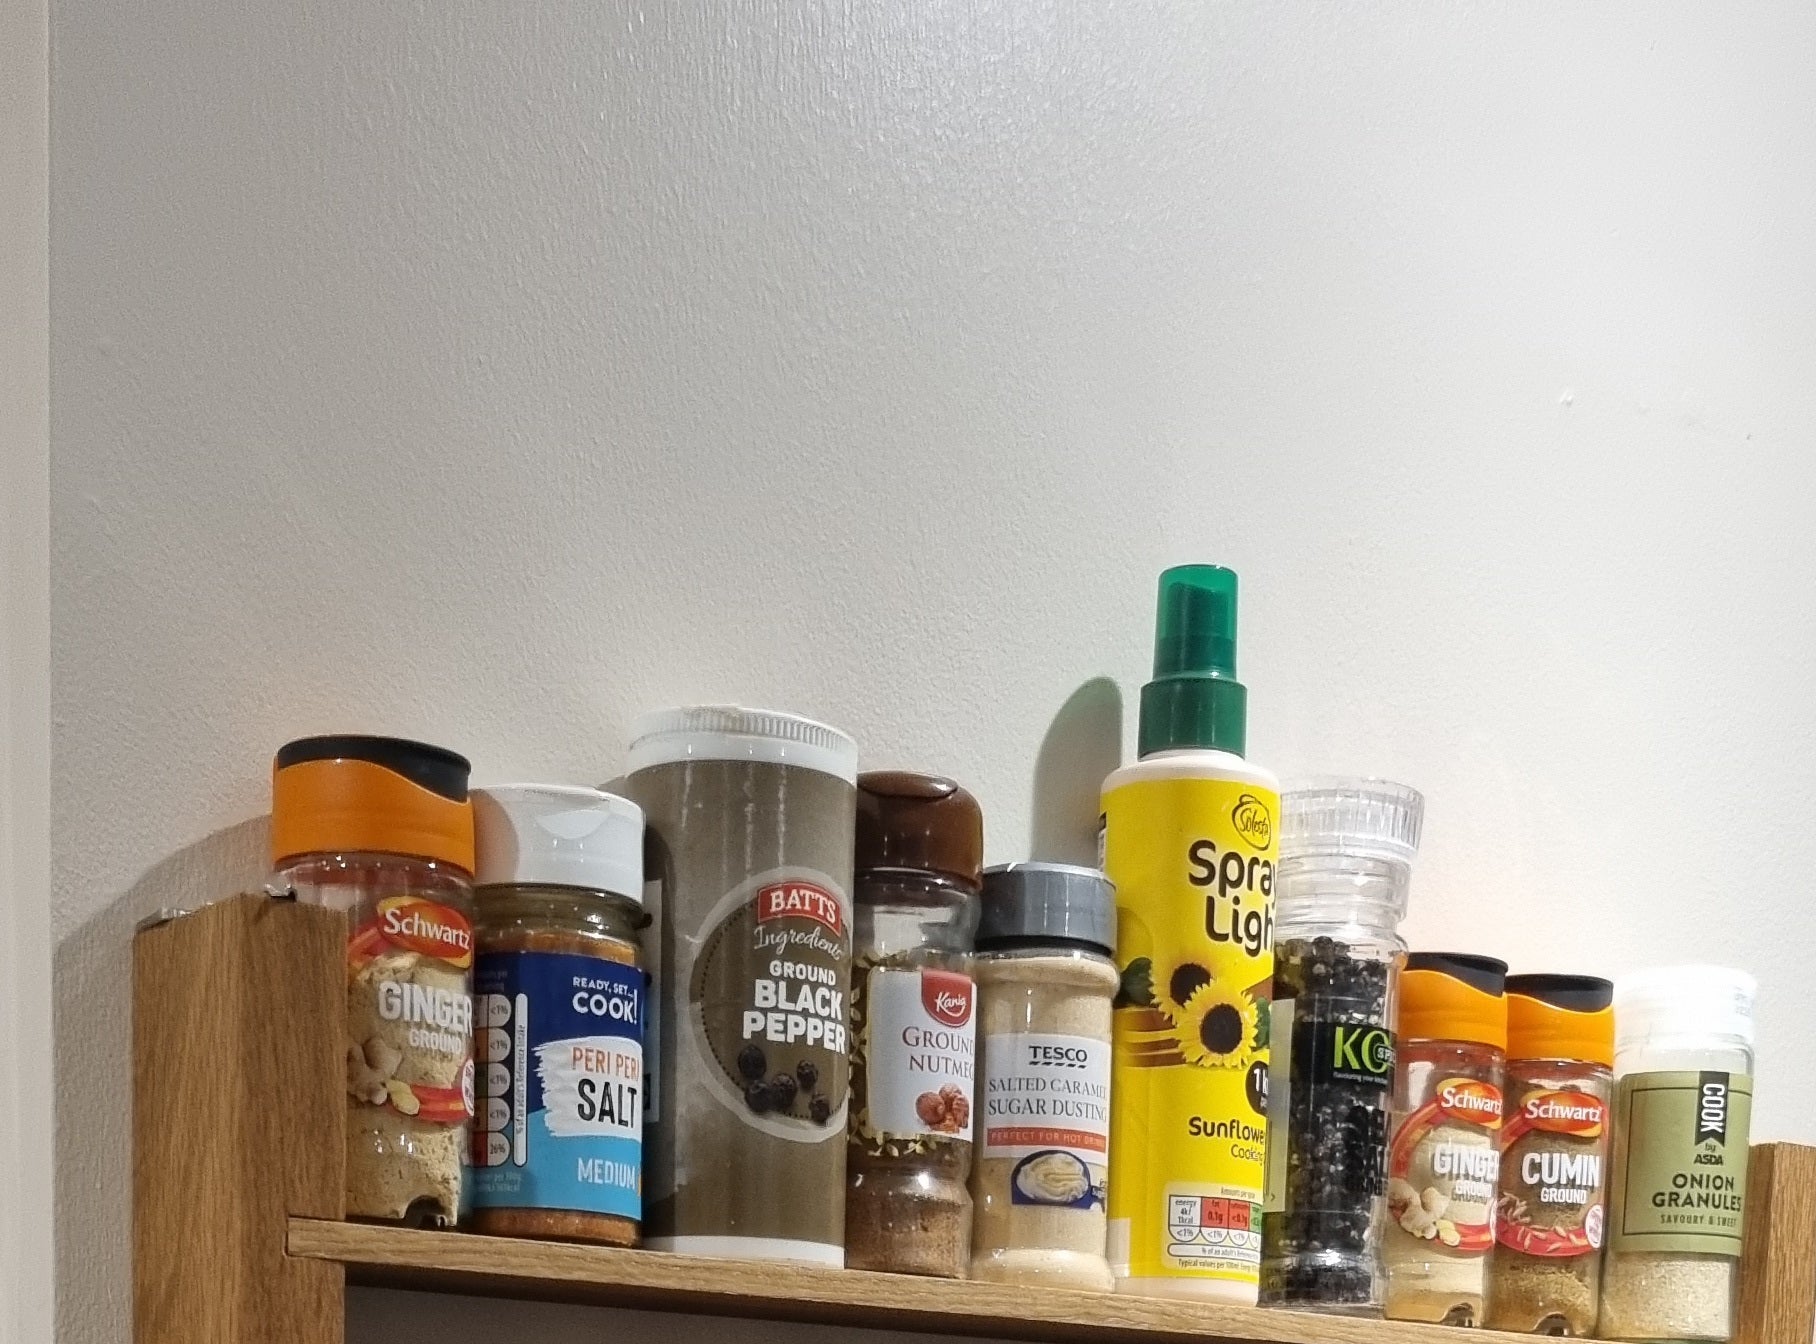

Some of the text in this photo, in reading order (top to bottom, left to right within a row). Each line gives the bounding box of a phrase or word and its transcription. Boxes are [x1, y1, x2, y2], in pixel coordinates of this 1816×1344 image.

[770, 889, 836, 924] BATTS
[383, 908, 471, 950] Schwartz
[1205, 896, 1275, 957] Ligh
[754, 925, 843, 960] Ingredients
[573, 976, 611, 993] READY,
[769, 959, 836, 986] GROUND
[379, 980, 472, 1037] GINGER
[572, 989, 638, 1024] COOK!
[754, 979, 843, 1021] BLACK
[409, 1028, 462, 1055] GROUND
[742, 1010, 846, 1055] PEPPER
[572, 1047, 640, 1081] PERI PERI
[1028, 1045, 1088, 1063] TESCO
[988, 1077, 1046, 1093] SALTED
[578, 1078, 638, 1129] SALT
[988, 1098, 1047, 1117] SUGAR
[1525, 1100, 1603, 1123] Schwartz
[1701, 1083, 1725, 1134] COOK
[991, 1131, 1034, 1141] PERFECT
[1040, 1132, 1059, 1141] FOR
[1064, 1134, 1081, 1143] HOT
[1188, 1116, 1264, 1144] Sunflowe
[1694, 1154, 1724, 1166] ASDA
[1705, 1142, 1716, 1153] by
[577, 1157, 636, 1190] MEDIUM
[1522, 1152, 1600, 1188] CUMIN
[1672, 1173, 1735, 1192] ONION
[1540, 1187, 1587, 1205] GROUND
[1652, 1192, 1742, 1212] GRANULES
[1661, 1214, 1704, 1225] SAVOURY
